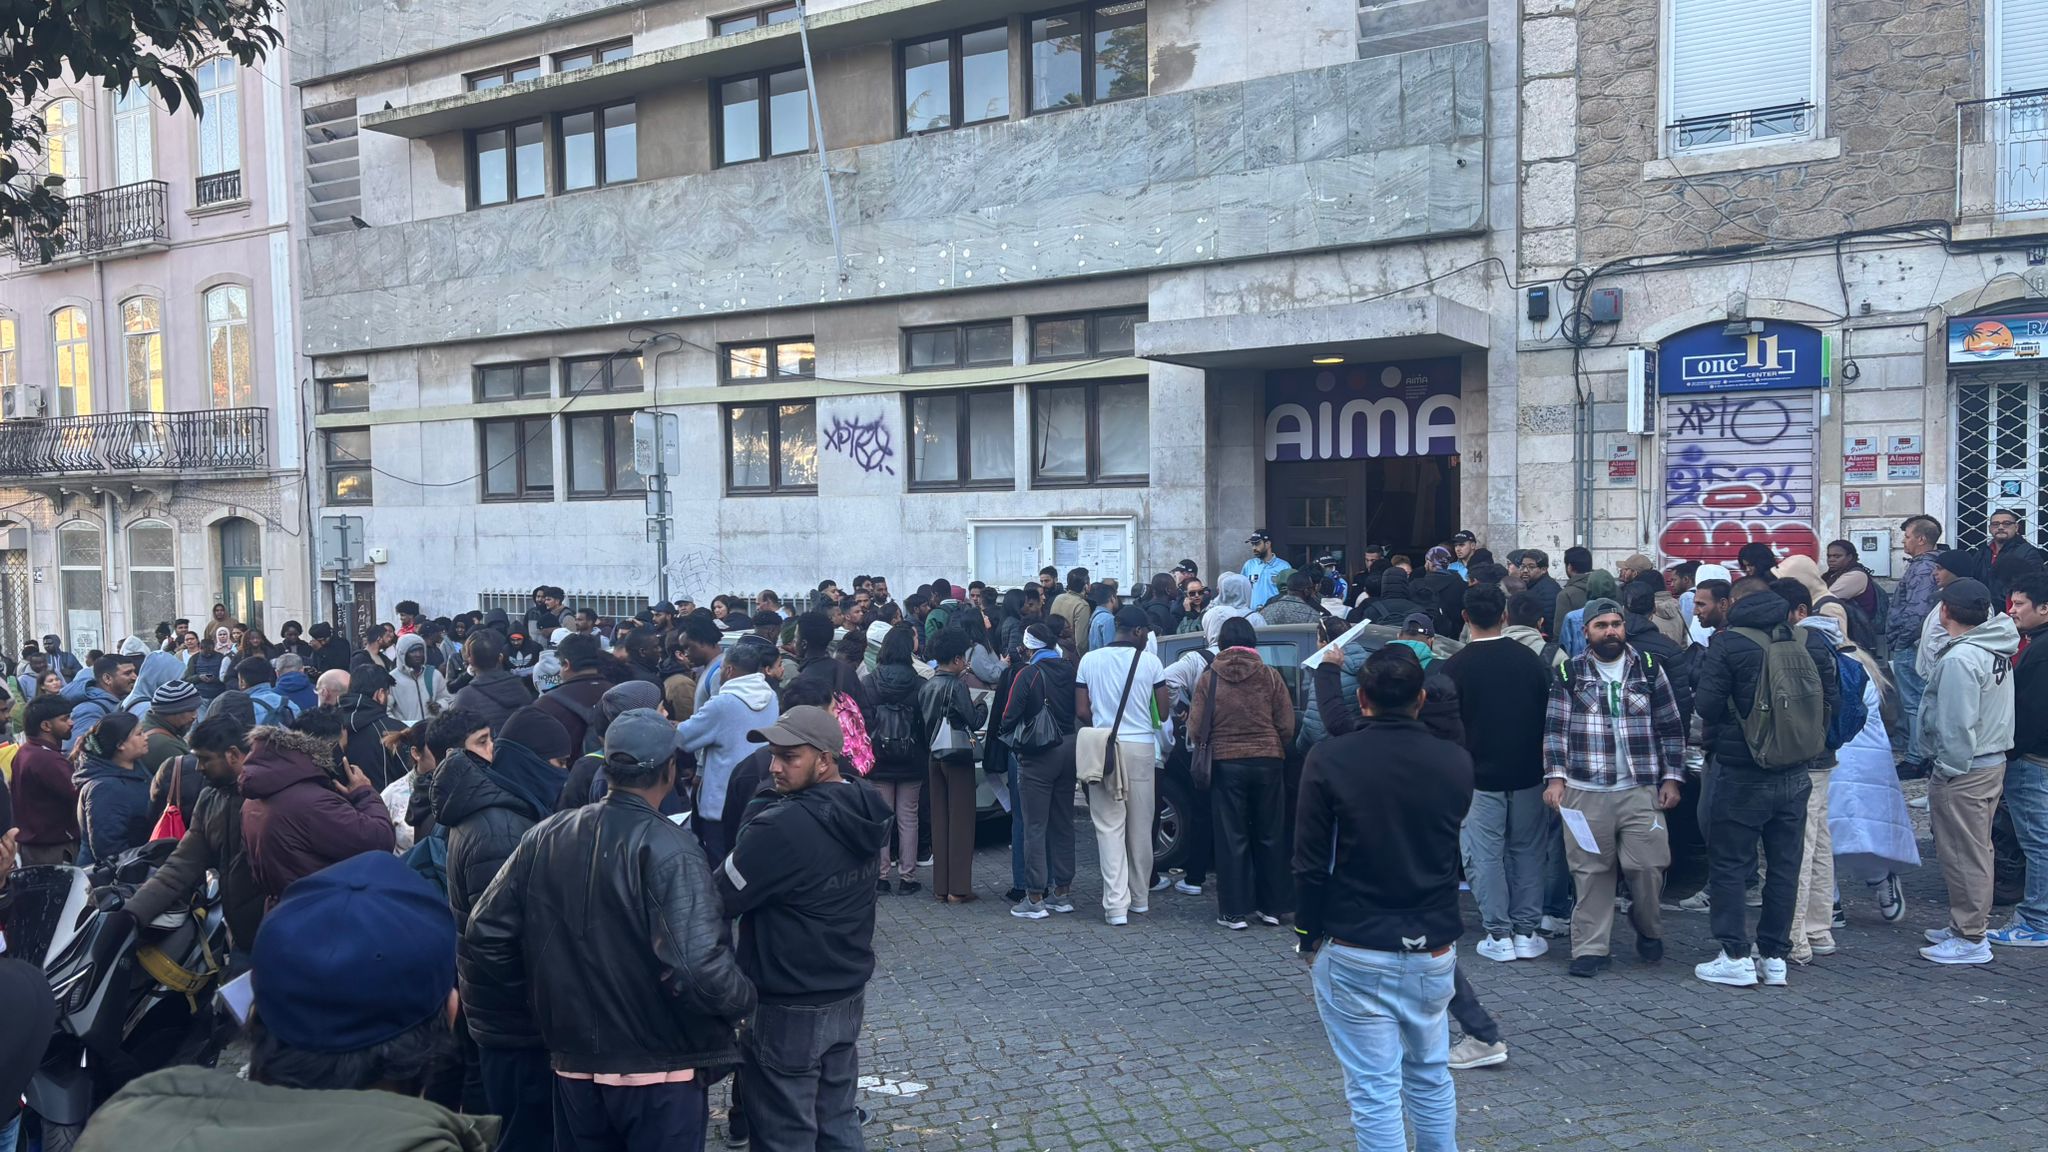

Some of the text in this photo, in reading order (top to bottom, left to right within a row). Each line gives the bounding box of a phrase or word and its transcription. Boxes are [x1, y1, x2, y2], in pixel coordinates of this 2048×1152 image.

[1698, 358, 1738, 374] one
[1265, 394, 1462, 461] AIMA
[1473, 450, 1482, 462] 14
